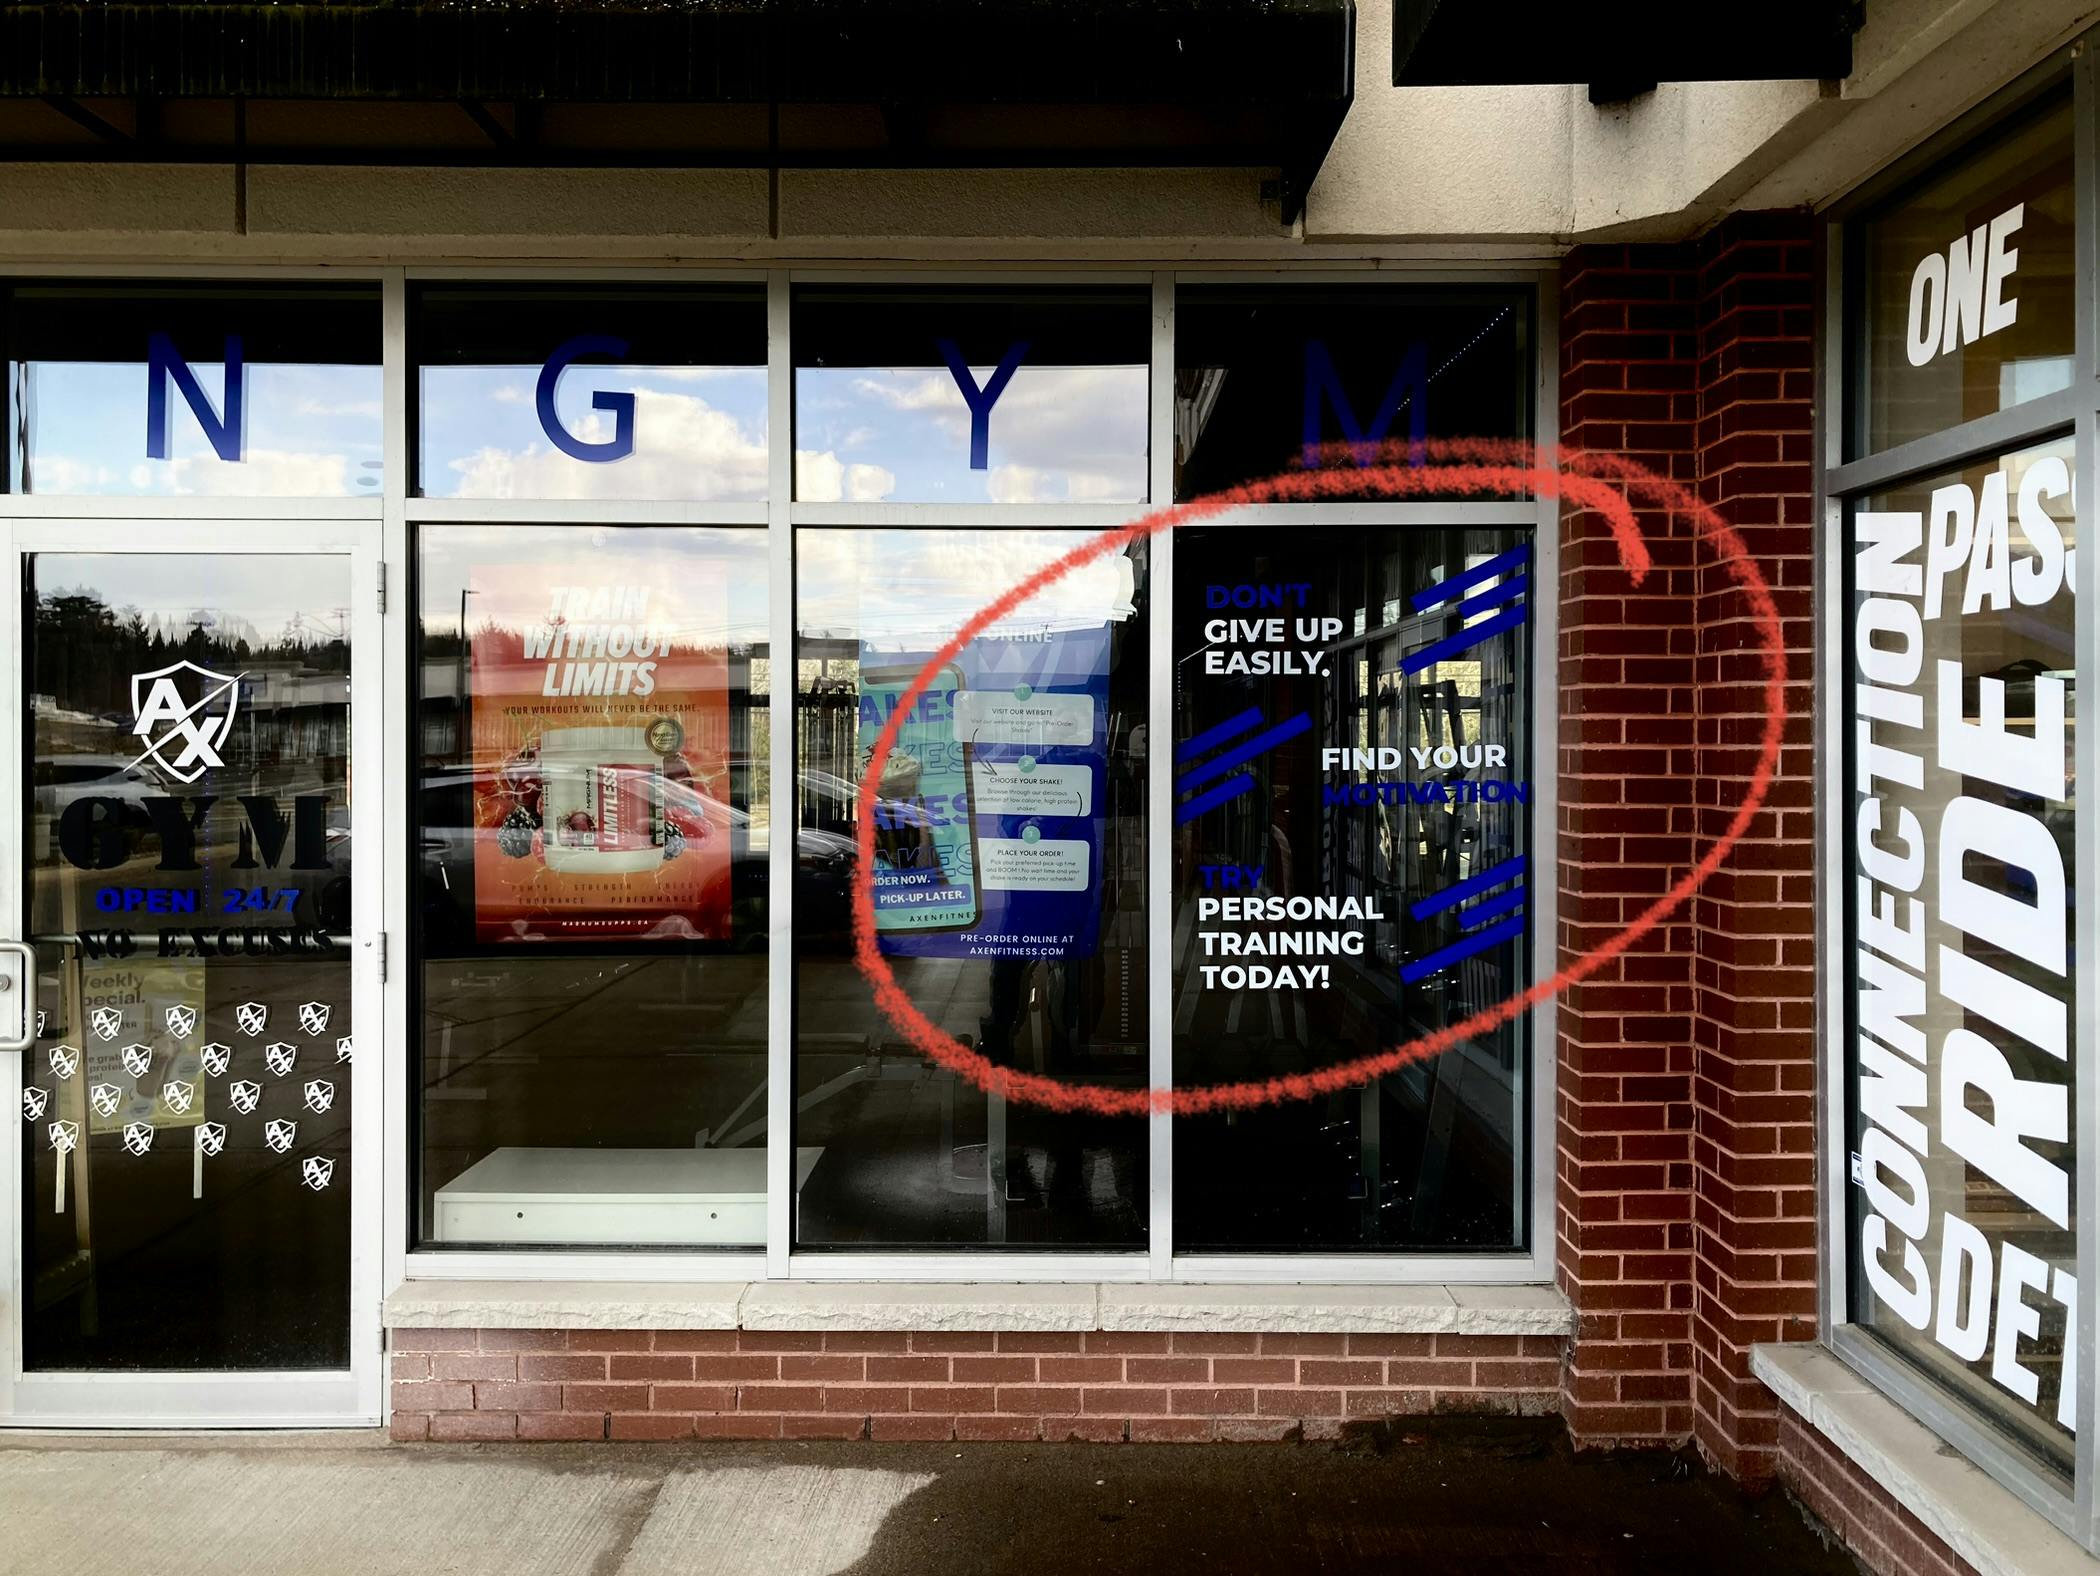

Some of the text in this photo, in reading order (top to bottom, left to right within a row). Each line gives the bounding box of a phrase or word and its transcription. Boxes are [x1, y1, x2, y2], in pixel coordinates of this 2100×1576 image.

[1907, 203, 2025, 366] ONE
[1924, 456, 2076, 620] PAS
[551, 586, 650, 620] TRAIN
[1205, 583, 1311, 609] DON'T
[523, 624, 679, 659] WITHOUT
[1204, 617, 1343, 643] GIVE UP
[1205, 651, 1330, 677] EASILY.
[542, 661, 657, 697] LIMITS
[133, 678, 225, 767] AX
[504, 706, 528, 715] YOUR
[532, 706, 579, 714] WORKOUTS
[582, 705, 603, 714] WILL
[607, 705, 636, 713] NEVER
[640, 704, 651, 712] BE
[653, 704, 670, 712] THE
[1322, 744, 1507, 771] FIND YOUR
[603, 767, 618, 846] LIMITLESS
[1324, 779, 1529, 809] MOTIVATION
[59, 795, 333, 870] GYM
[900, 874, 931, 885] NOW.
[1200, 865, 1264, 889] TRY
[95, 887, 300, 913] OPEN 24/7
[880, 890, 966, 904] PICK-UP LATER.
[1198, 896, 1384, 922] PERSONAL
[1855, 511, 1932, 1331] CONNECTION
[73, 926, 337, 960] NO EXCUSES
[960, 934, 1074, 944] PRE-ORDER ONLINE AT
[969, 947, 1064, 956] AXENFITNESS.COM
[1199, 931, 1364, 956] TRAINING
[1938, 660, 2068, 1230] RIDE
[1200, 964, 1330, 989] TODAY!
